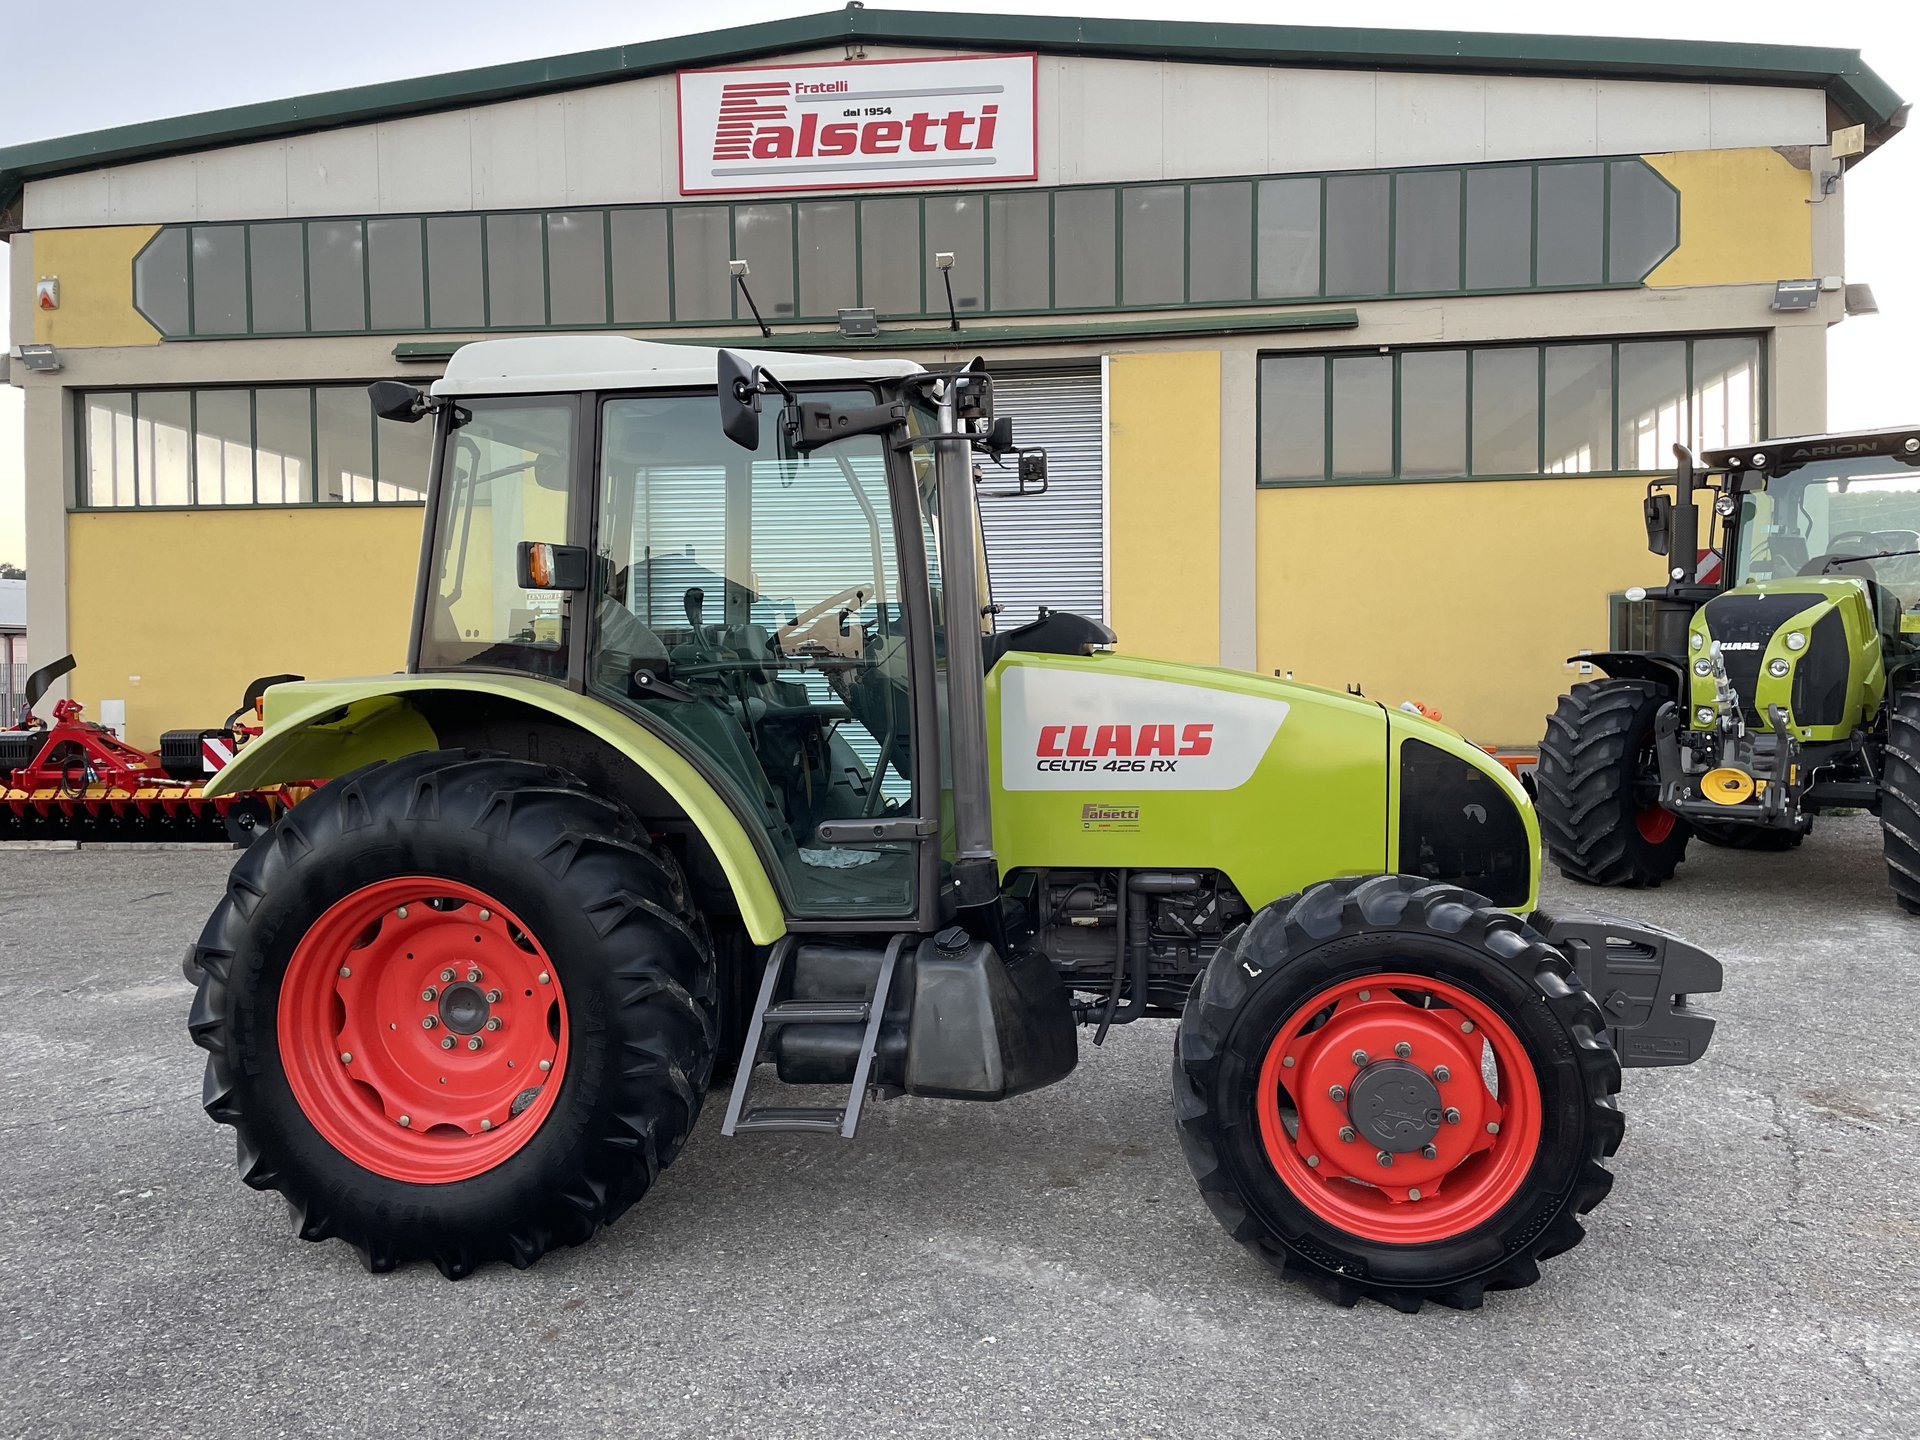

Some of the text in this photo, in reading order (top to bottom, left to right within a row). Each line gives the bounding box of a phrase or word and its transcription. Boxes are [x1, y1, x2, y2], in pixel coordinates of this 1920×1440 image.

[795, 80, 848, 94] Fratelli
[843, 107, 892, 117] dal 1954
[1792, 441, 1878, 458] ARION
[1720, 642, 1760, 651] CLAAS
[1036, 724, 1214, 757] CLAAS
[1037, 759, 1178, 772] CELTIS 426 RX
[1081, 803, 1139, 819] Falsetti
